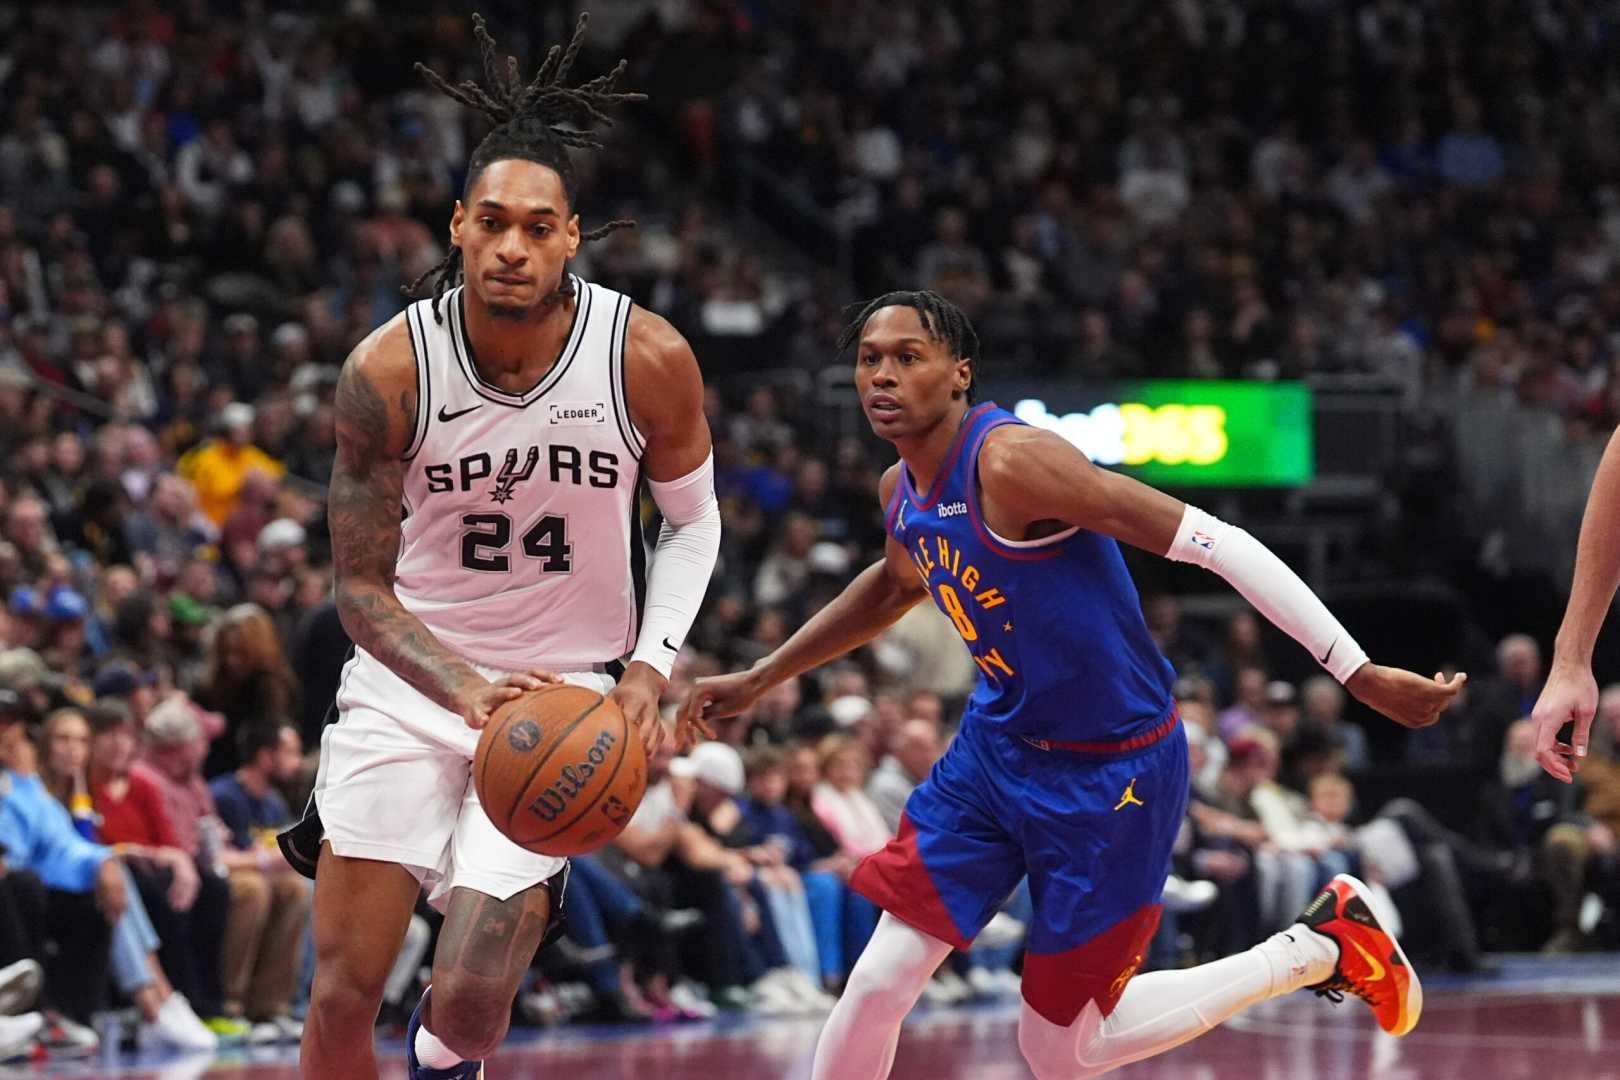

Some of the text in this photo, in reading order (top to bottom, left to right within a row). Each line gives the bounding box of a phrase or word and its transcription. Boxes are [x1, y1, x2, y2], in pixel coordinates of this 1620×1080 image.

[556, 408, 598, 419] LEDGER
[424, 444, 619, 502] SPURS
[937, 501, 968, 518] ibotta
[459, 510, 574, 574] 24
[937, 536, 1006, 609] HIGH
[938, 583, 978, 641] 8
[528, 731, 617, 822] Wilson
